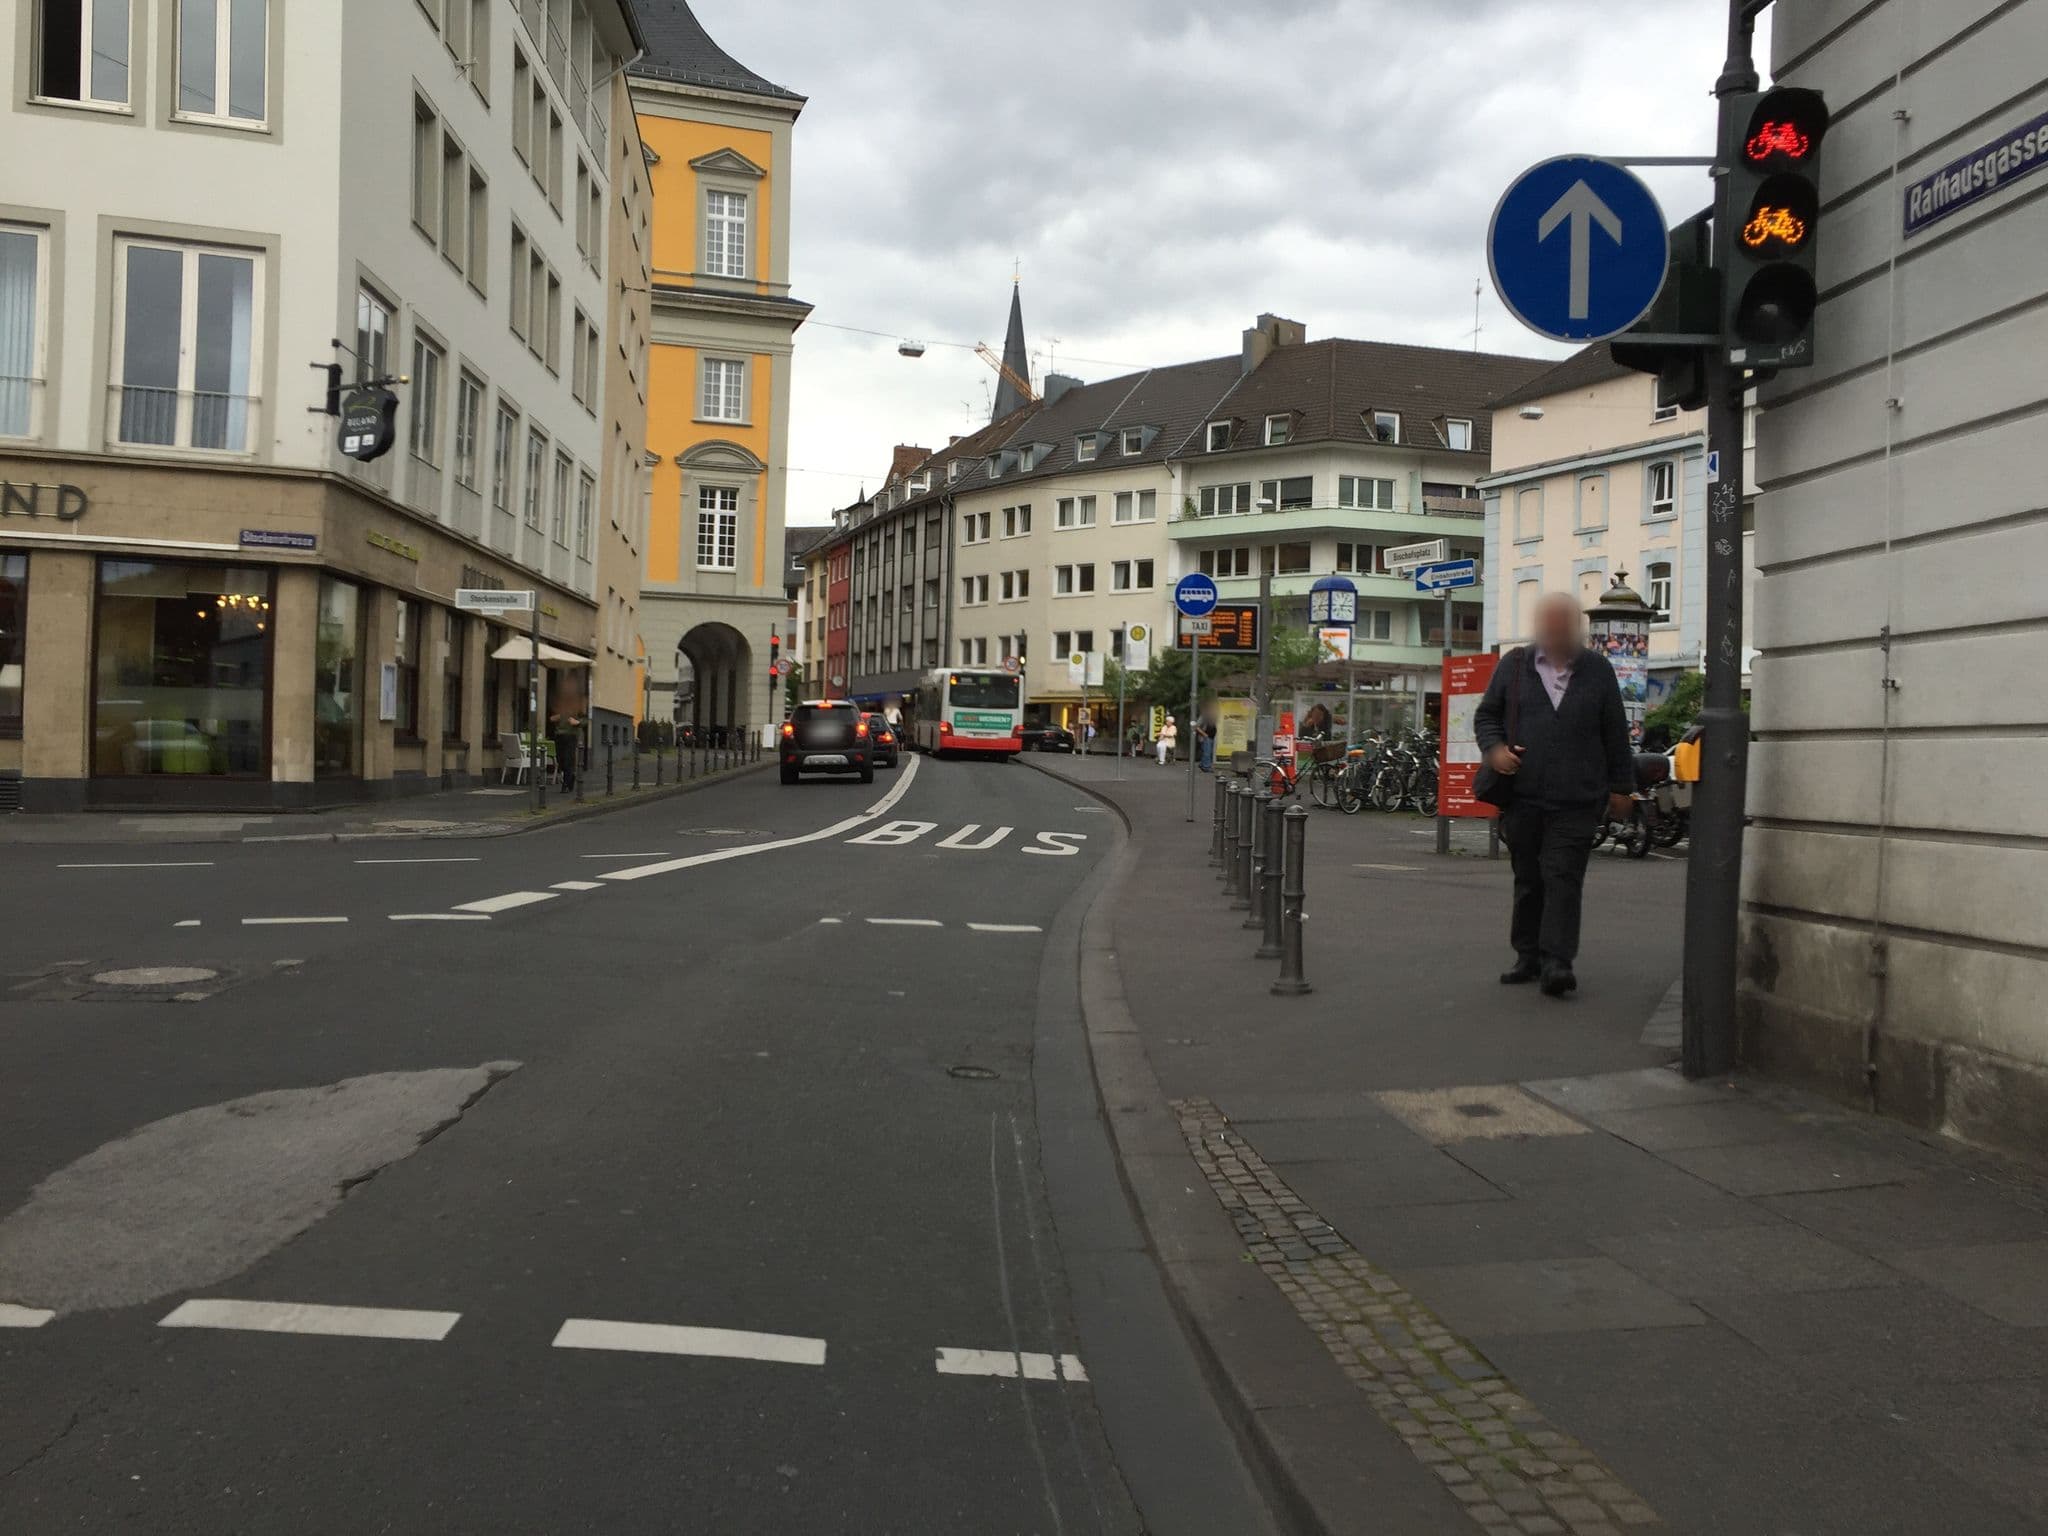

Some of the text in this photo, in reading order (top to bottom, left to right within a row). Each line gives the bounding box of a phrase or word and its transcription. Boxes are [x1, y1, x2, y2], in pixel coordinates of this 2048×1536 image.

[1910, 124, 2048, 223] Rathausgasse
[1192, 621, 1208, 631] TAXI
[844, 820, 1087, 856] BUS
